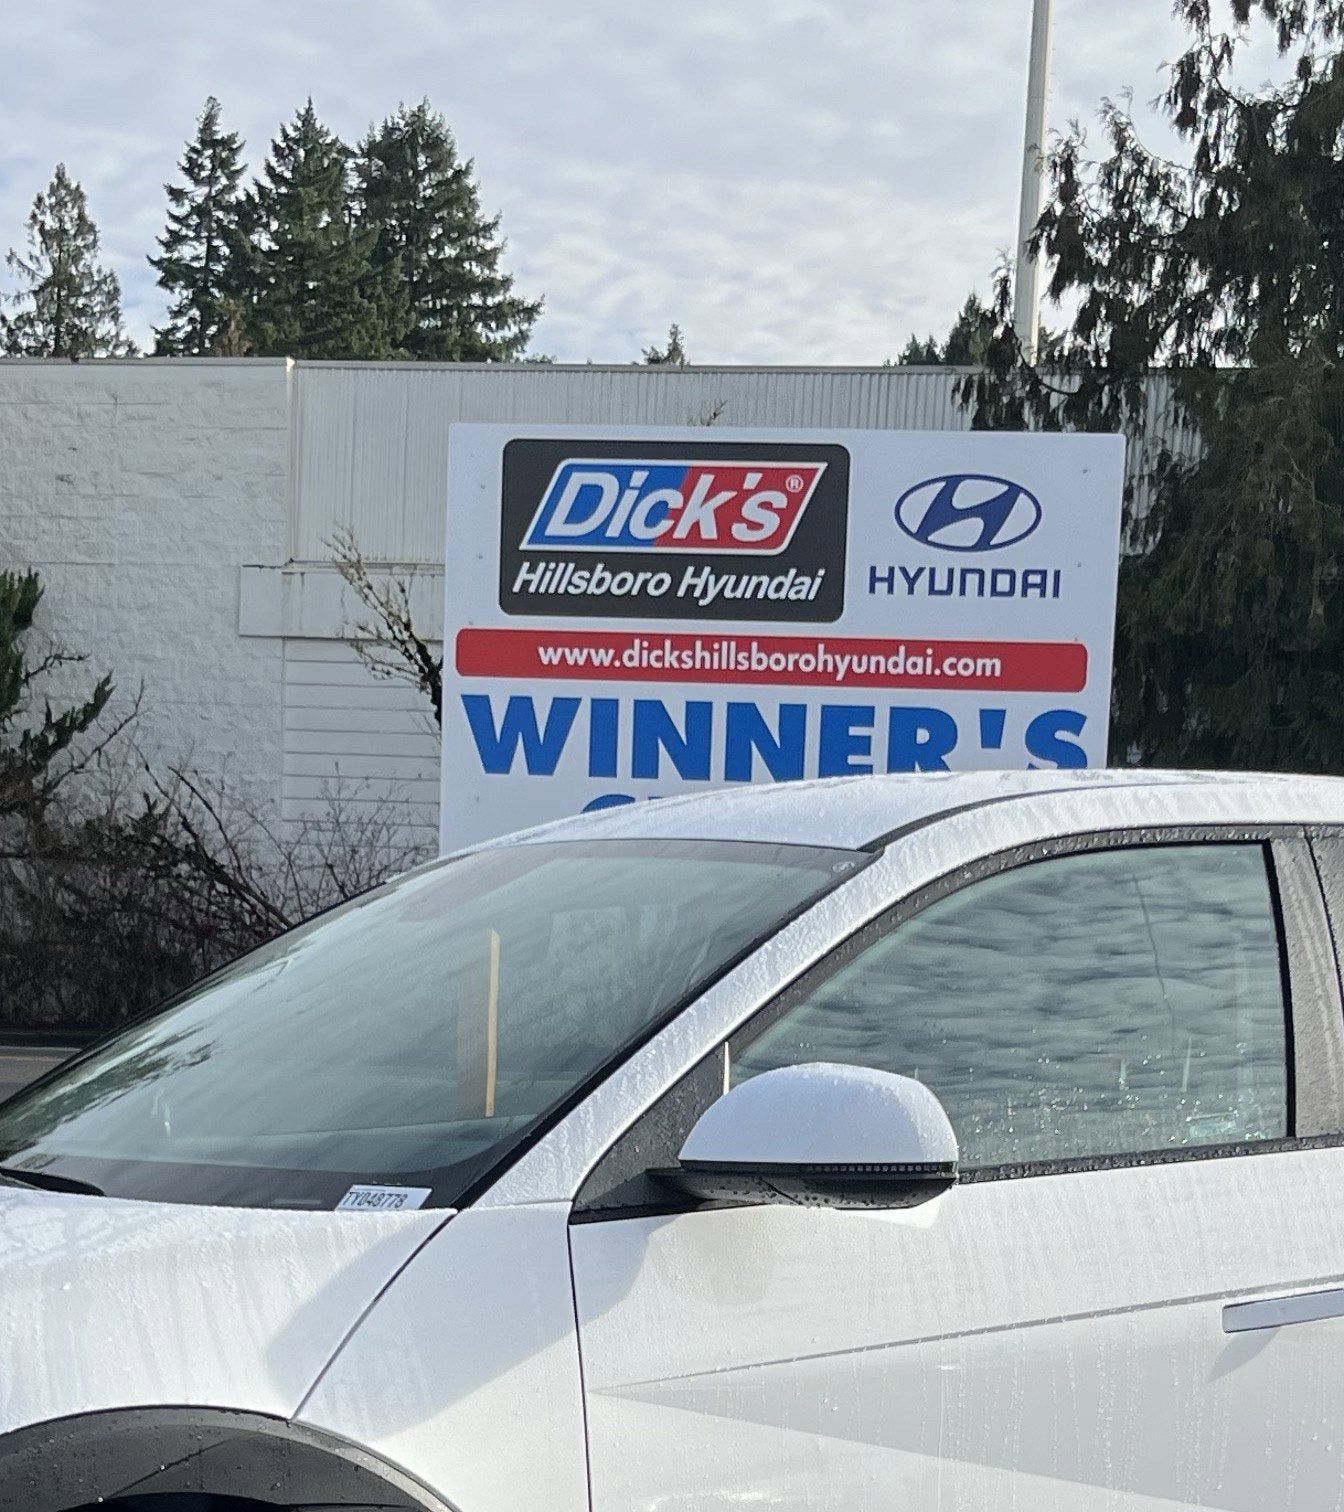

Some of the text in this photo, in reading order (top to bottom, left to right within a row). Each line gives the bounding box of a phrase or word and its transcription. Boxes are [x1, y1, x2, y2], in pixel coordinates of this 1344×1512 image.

[511, 561, 826, 606] Hillsboro Hyundai
[868, 566, 1061, 599] HYUNDAI
[538, 640, 1002, 681] www.dickshillsborohyundai.com
[460, 694, 1089, 781] WINNER'S
